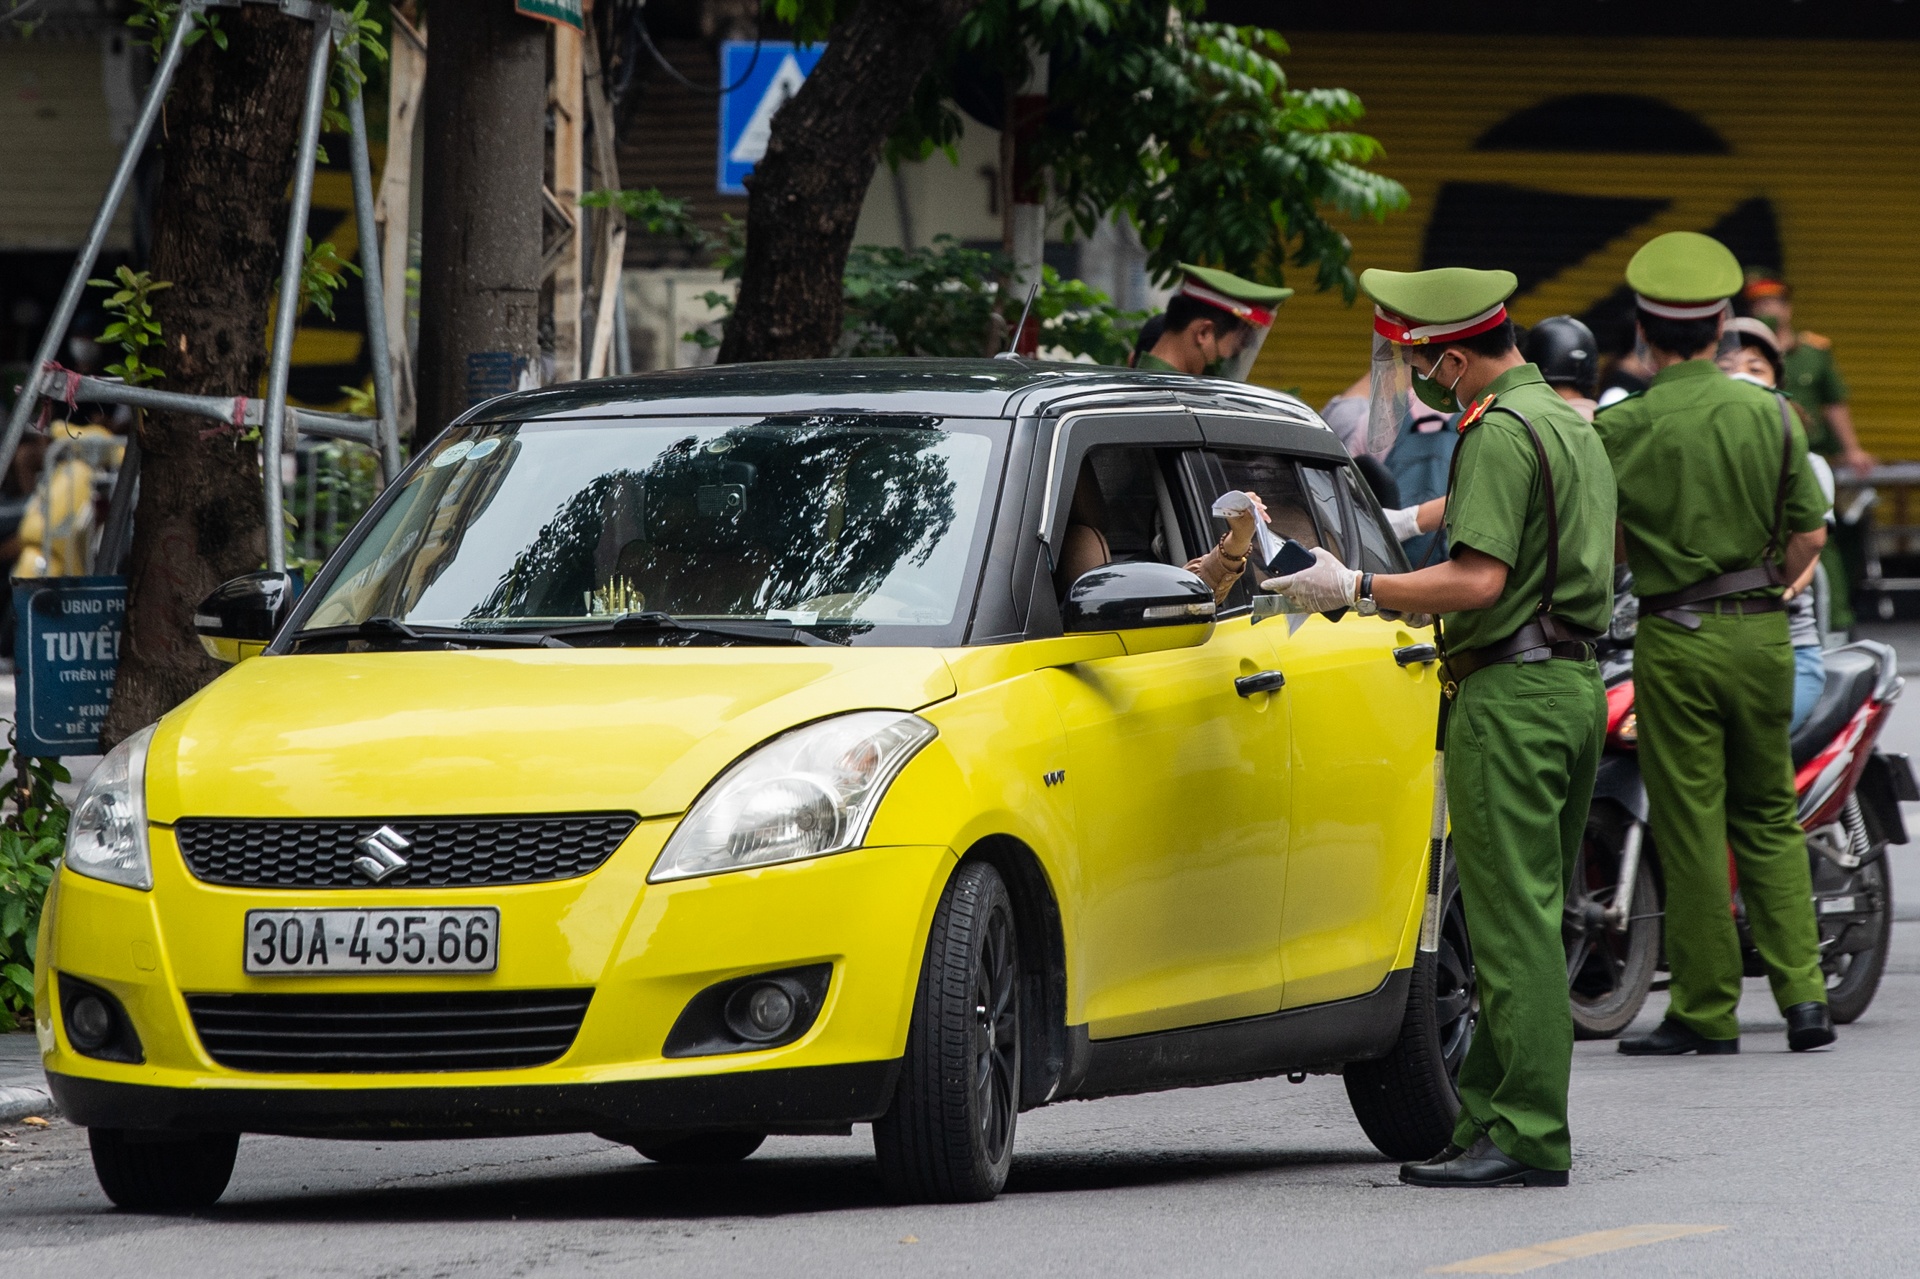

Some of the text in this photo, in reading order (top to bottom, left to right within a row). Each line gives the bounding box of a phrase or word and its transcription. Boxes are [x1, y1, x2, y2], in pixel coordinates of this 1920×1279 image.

[61, 599, 102, 614] UBND
[42, 620, 122, 662] TUYẾ
[254, 916, 489, 965] 30A-435.66
